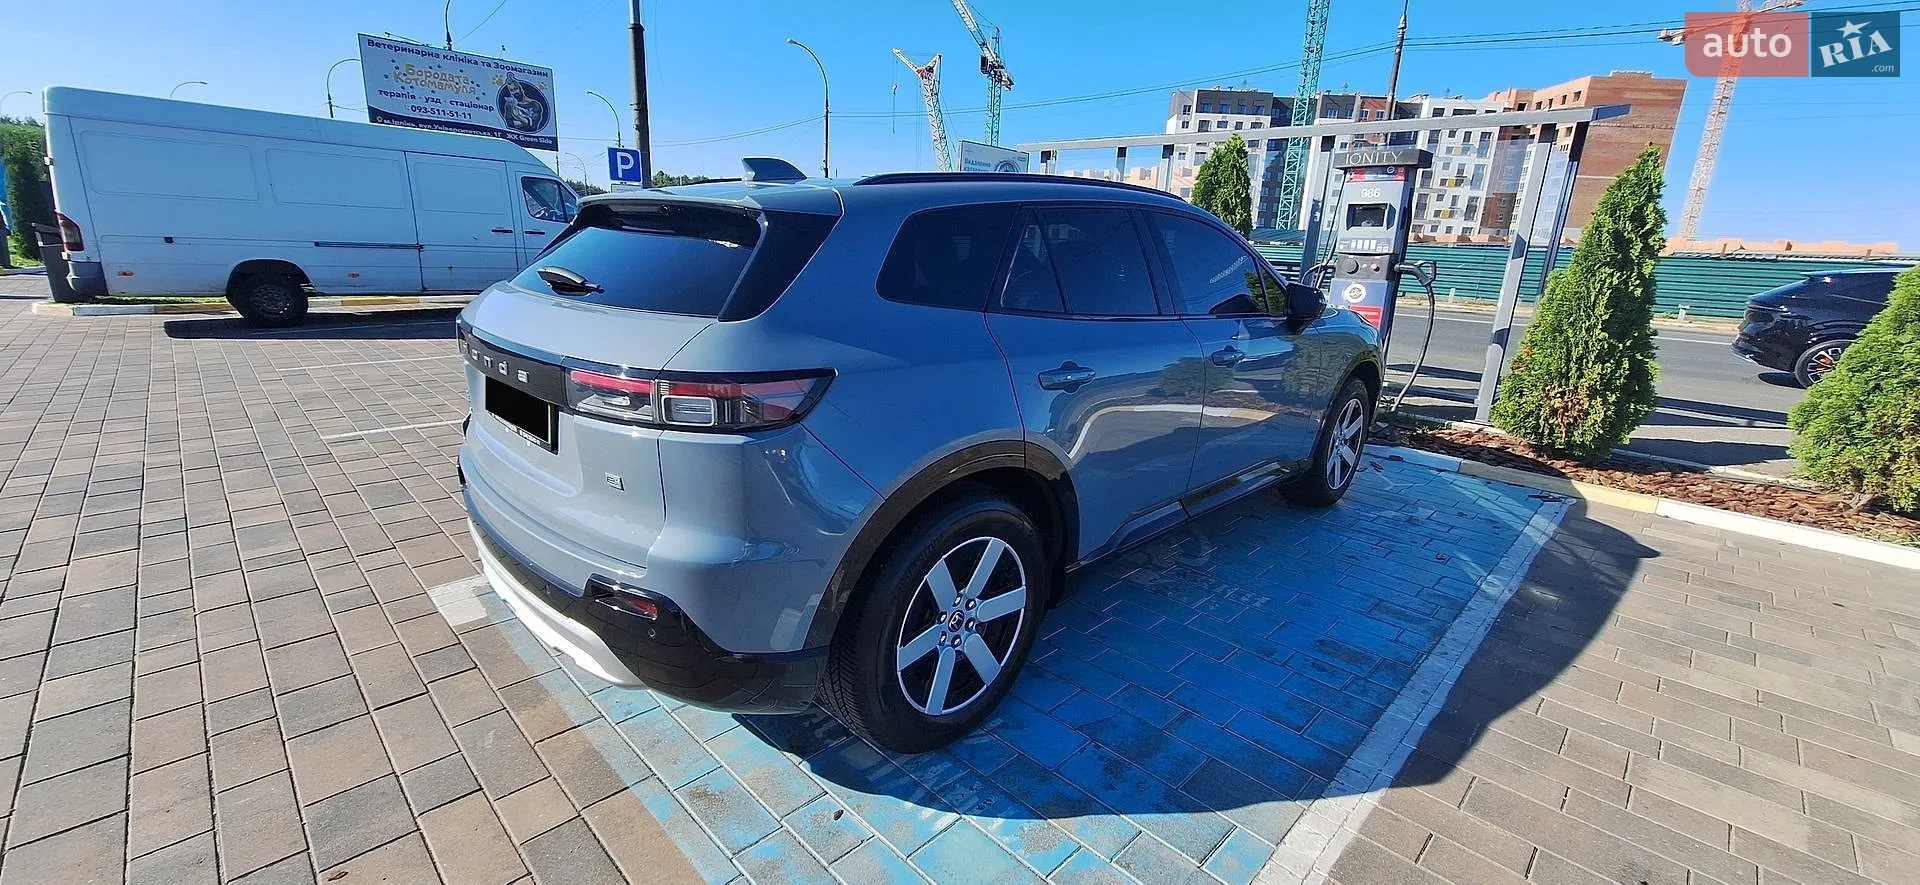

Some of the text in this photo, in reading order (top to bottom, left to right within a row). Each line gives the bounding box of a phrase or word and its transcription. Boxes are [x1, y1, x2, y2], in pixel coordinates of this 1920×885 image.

[367, 39, 549, 78] Ветеринарна клініка та Зоомагазин
[392, 71, 477, 95] Котомамуля
[404, 63, 470, 84] Бородата
[377, 88, 495, 112] терапія узд стаціонар
[410, 105, 472, 120] 093-511-51-11
[519, 134, 539, 143] Green
[539, 136, 553, 145] Side
[616, 151, 635, 179] P
[1345, 150, 1404, 166] IONITY
[1360, 188, 1382, 199] 986
